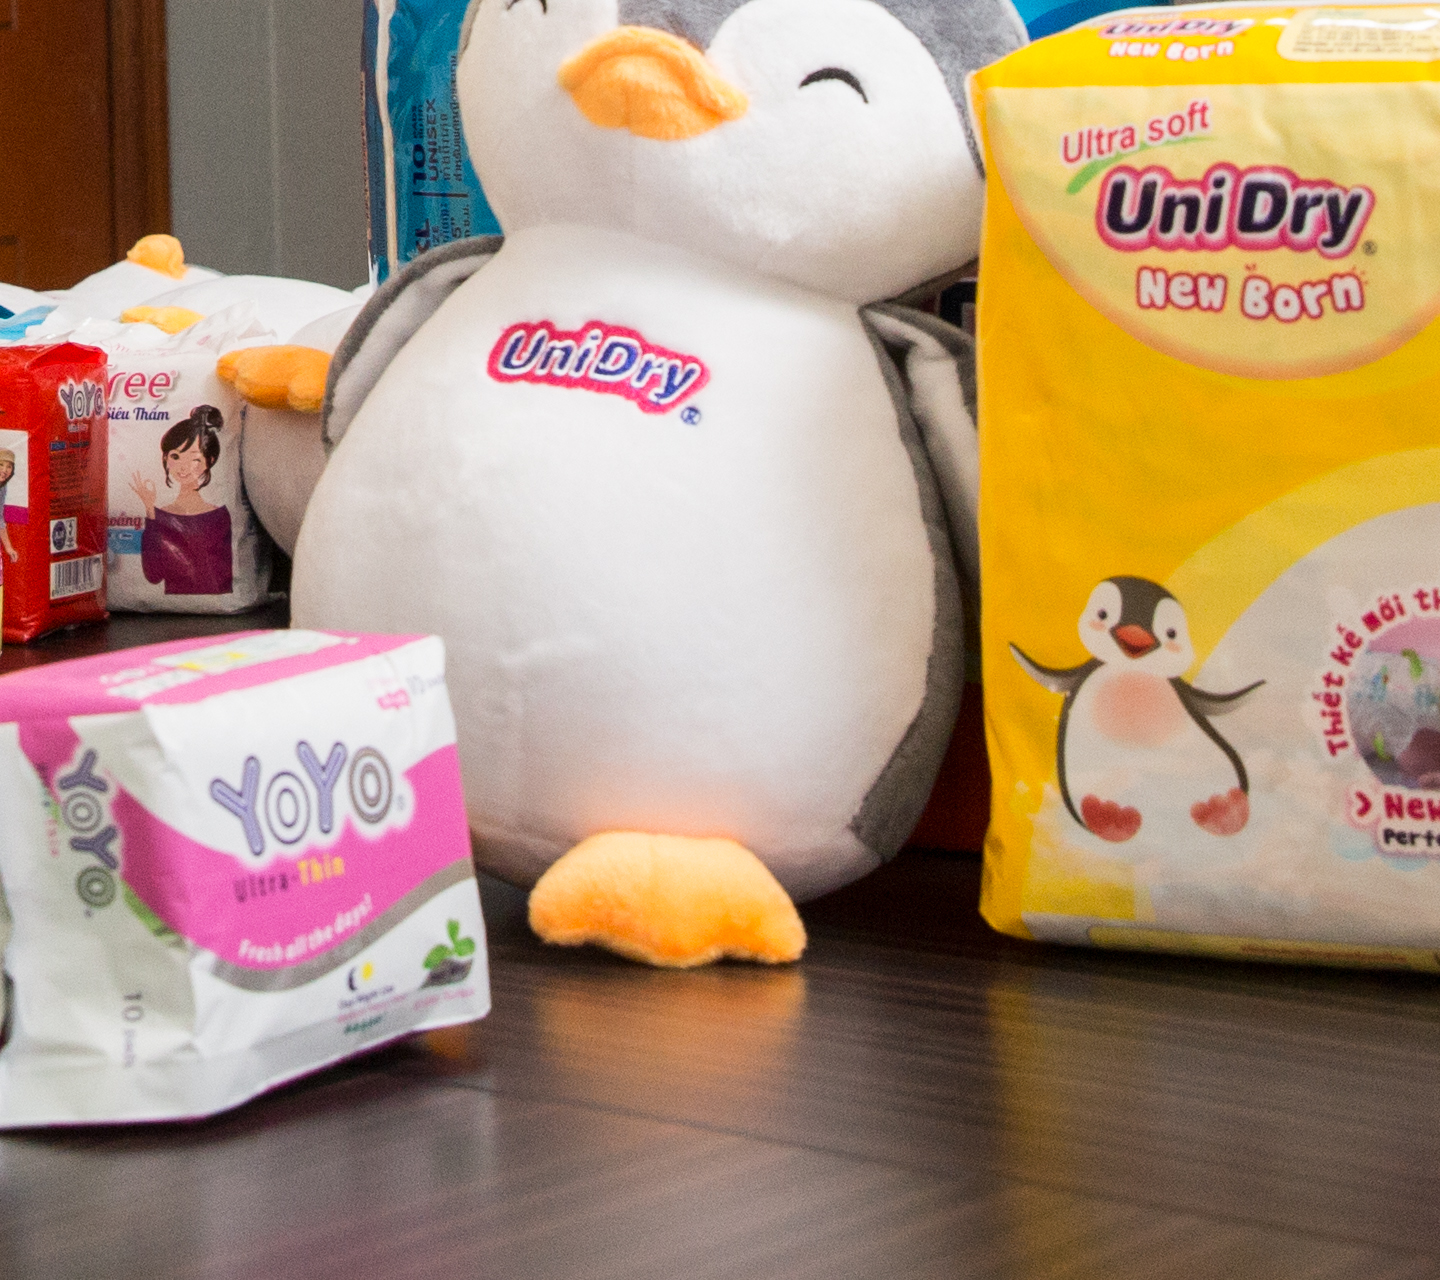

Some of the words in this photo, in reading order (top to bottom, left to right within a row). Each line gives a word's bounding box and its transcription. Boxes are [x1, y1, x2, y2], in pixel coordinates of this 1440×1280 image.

[1108, 40, 1160, 58] New
[1166, 40, 1234, 62] Born
[411, 143, 428, 186] 10
[425, 97, 439, 183] UNISEX
[1061, 124, 1136, 167] Ultra
[1148, 99, 1211, 142] soft
[1098, 164, 1372, 256] UniDry
[1136, 266, 1227, 318] New
[1239, 266, 1366, 324] Born
[494, 324, 705, 407] UniDry
[132, 404, 170, 421] Thấm
[209, 740, 394, 858] YOYO
[122, 990, 145, 1023] 10
